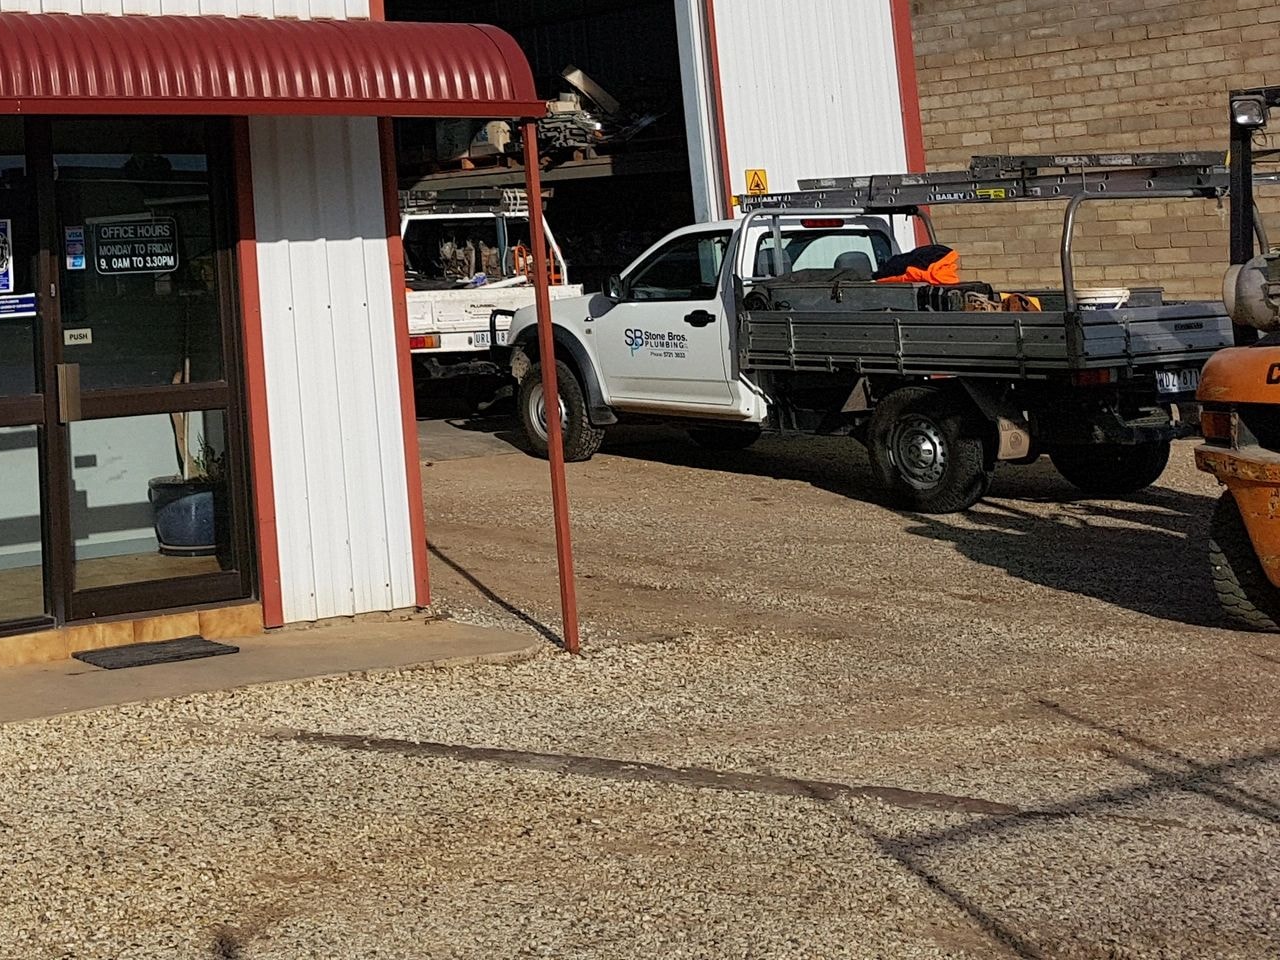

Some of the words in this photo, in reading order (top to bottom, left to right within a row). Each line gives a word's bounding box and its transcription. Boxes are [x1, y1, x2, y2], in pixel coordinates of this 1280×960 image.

[101, 226, 135, 239] OFFICE
[137, 224, 170, 237] HOURS
[99, 244, 132, 256] MONDAY
[134, 244, 146, 254] TO
[147, 243, 173, 254] FRIDAY
[132, 257, 144, 268] TO
[69, 333, 88, 341] PUSH
[644, 331, 666, 341] Stone
[667, 332, 688, 342] Bros.
[644, 340, 684, 349] PLUMBING
